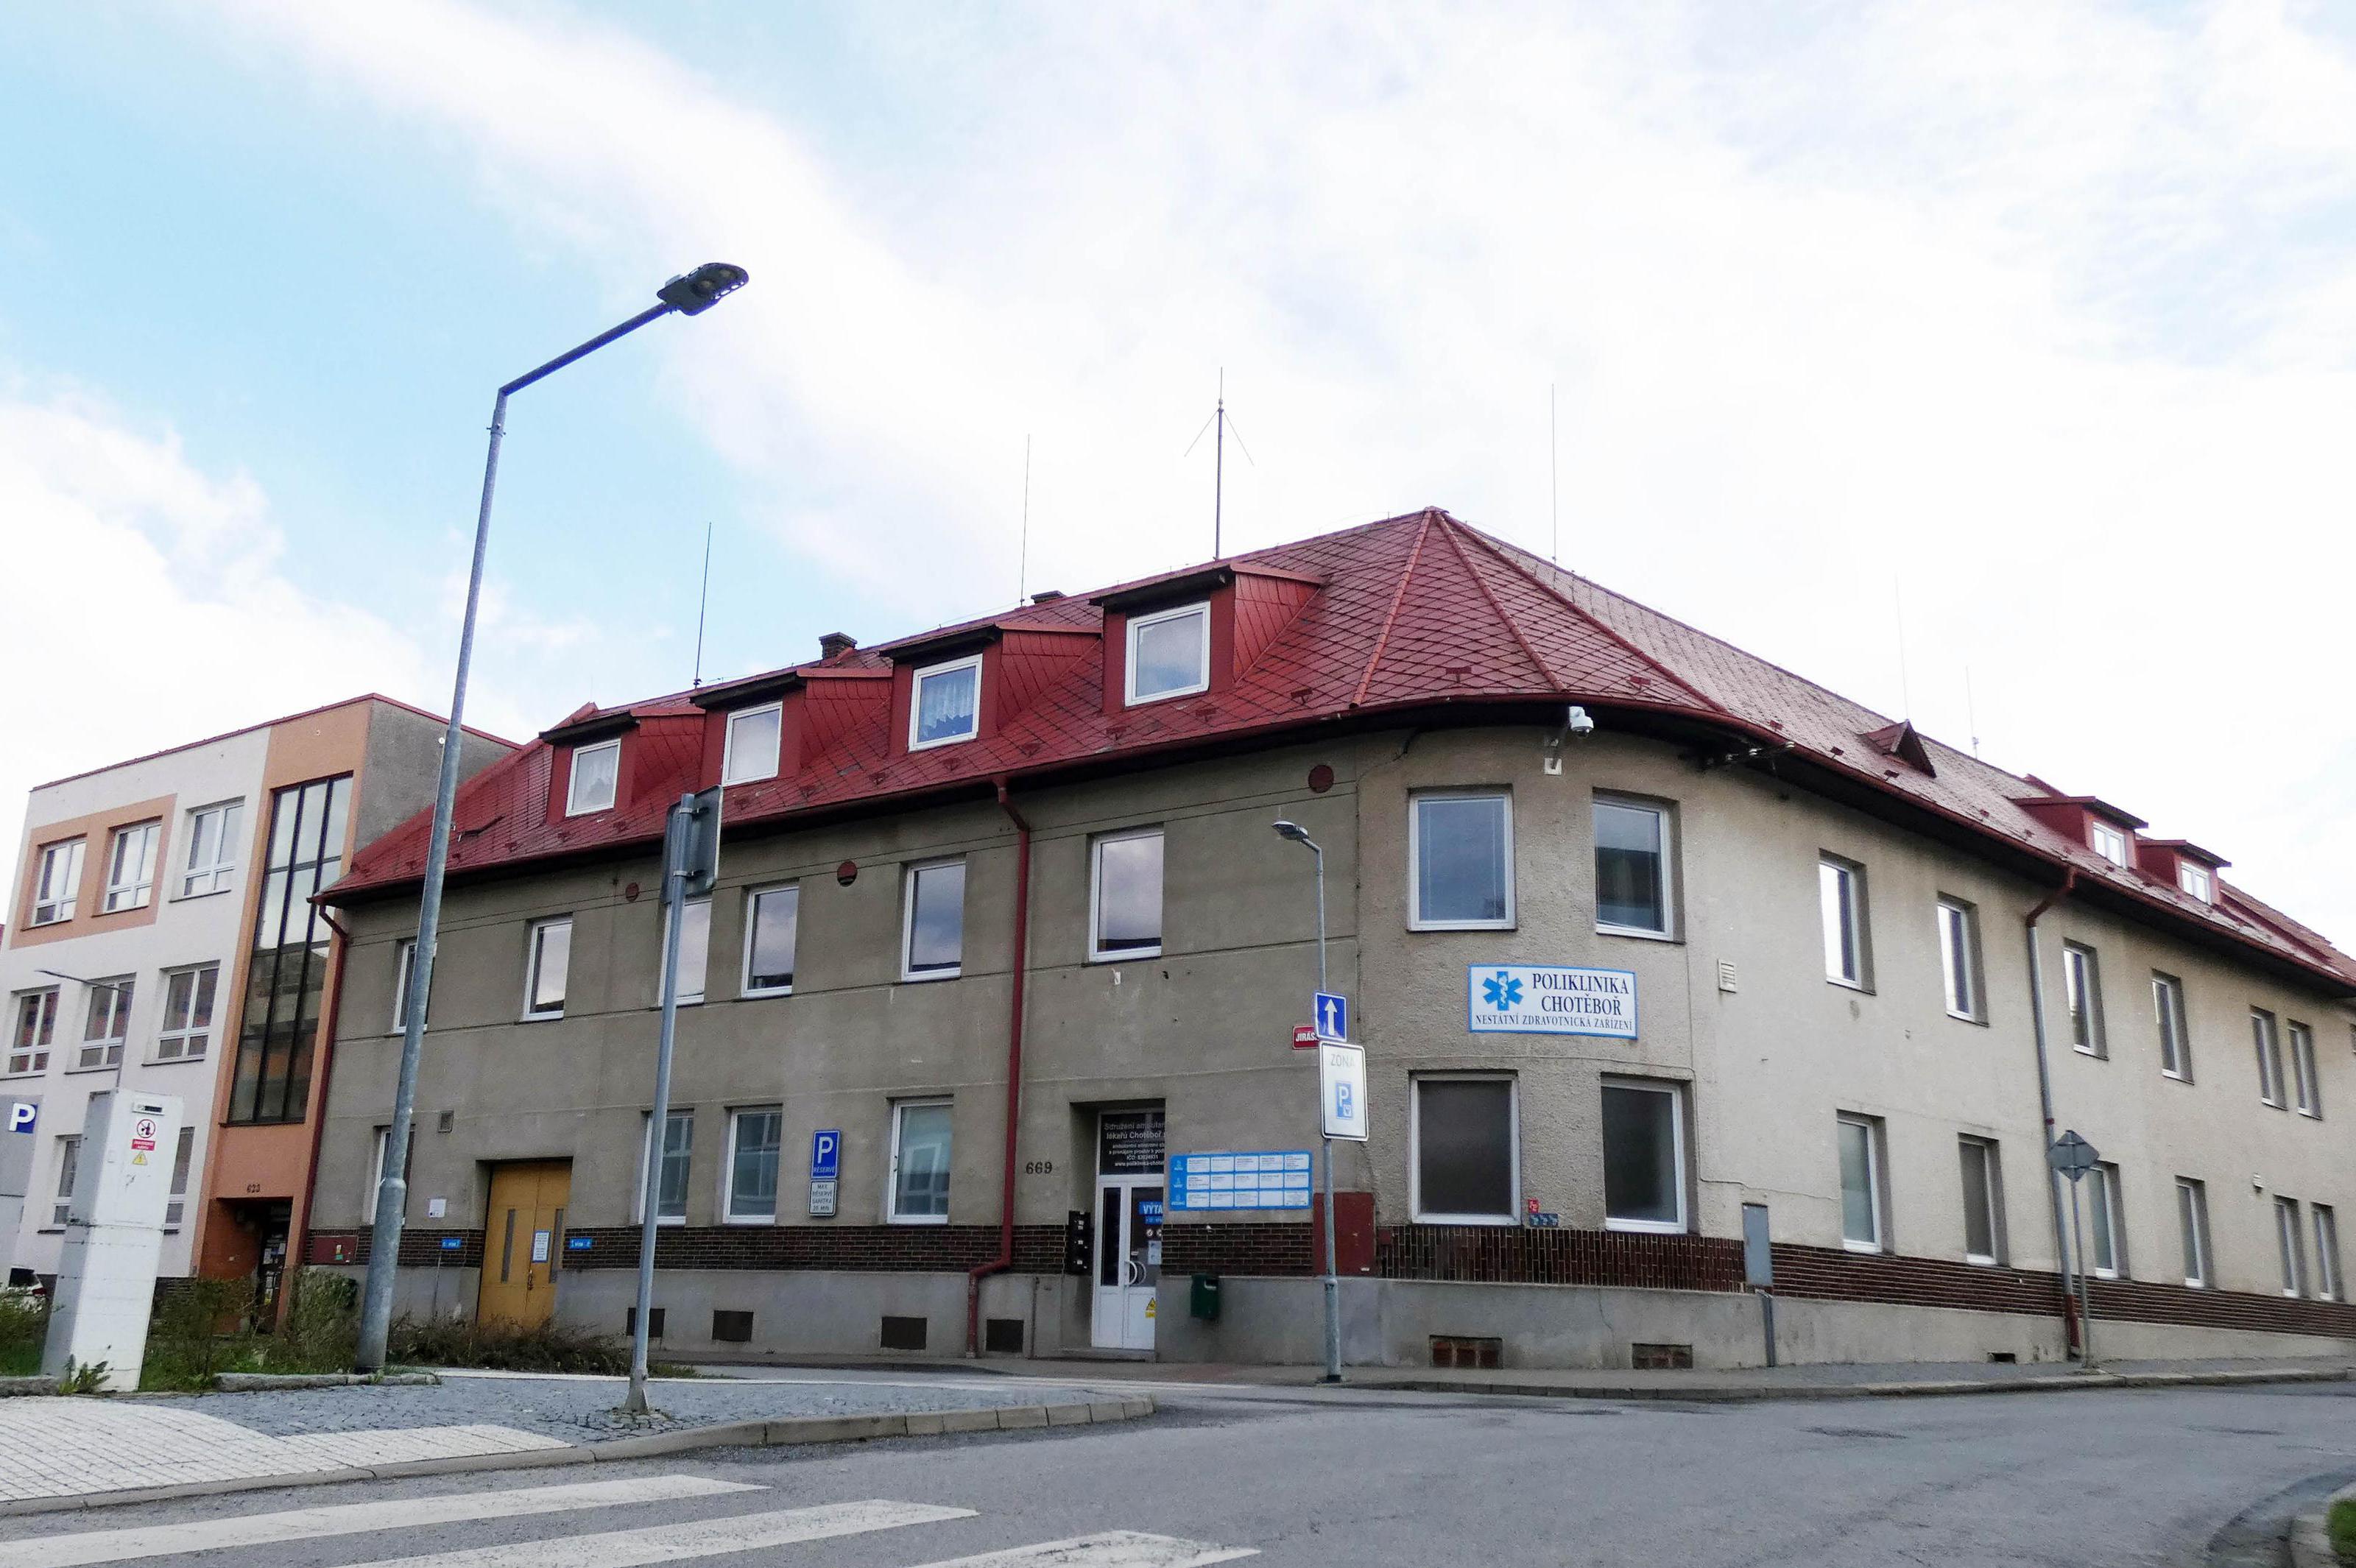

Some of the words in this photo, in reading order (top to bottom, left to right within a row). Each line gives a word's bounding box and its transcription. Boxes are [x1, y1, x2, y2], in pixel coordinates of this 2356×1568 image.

[1533, 973, 1629, 994] POLIKLINIKA
[1542, 994, 1622, 1015] CHOTĚBOŘ
[1476, 1013, 1519, 1025] NESTÁTNÍ
[1523, 1015, 1591, 1028] ZDRAVOTNICKÁ
[9, 1103, 36, 1131] P
[1129, 1130, 1161, 1139] Chotěboř
[817, 1137, 833, 1164] P
[1026, 1162, 1053, 1174] 669
